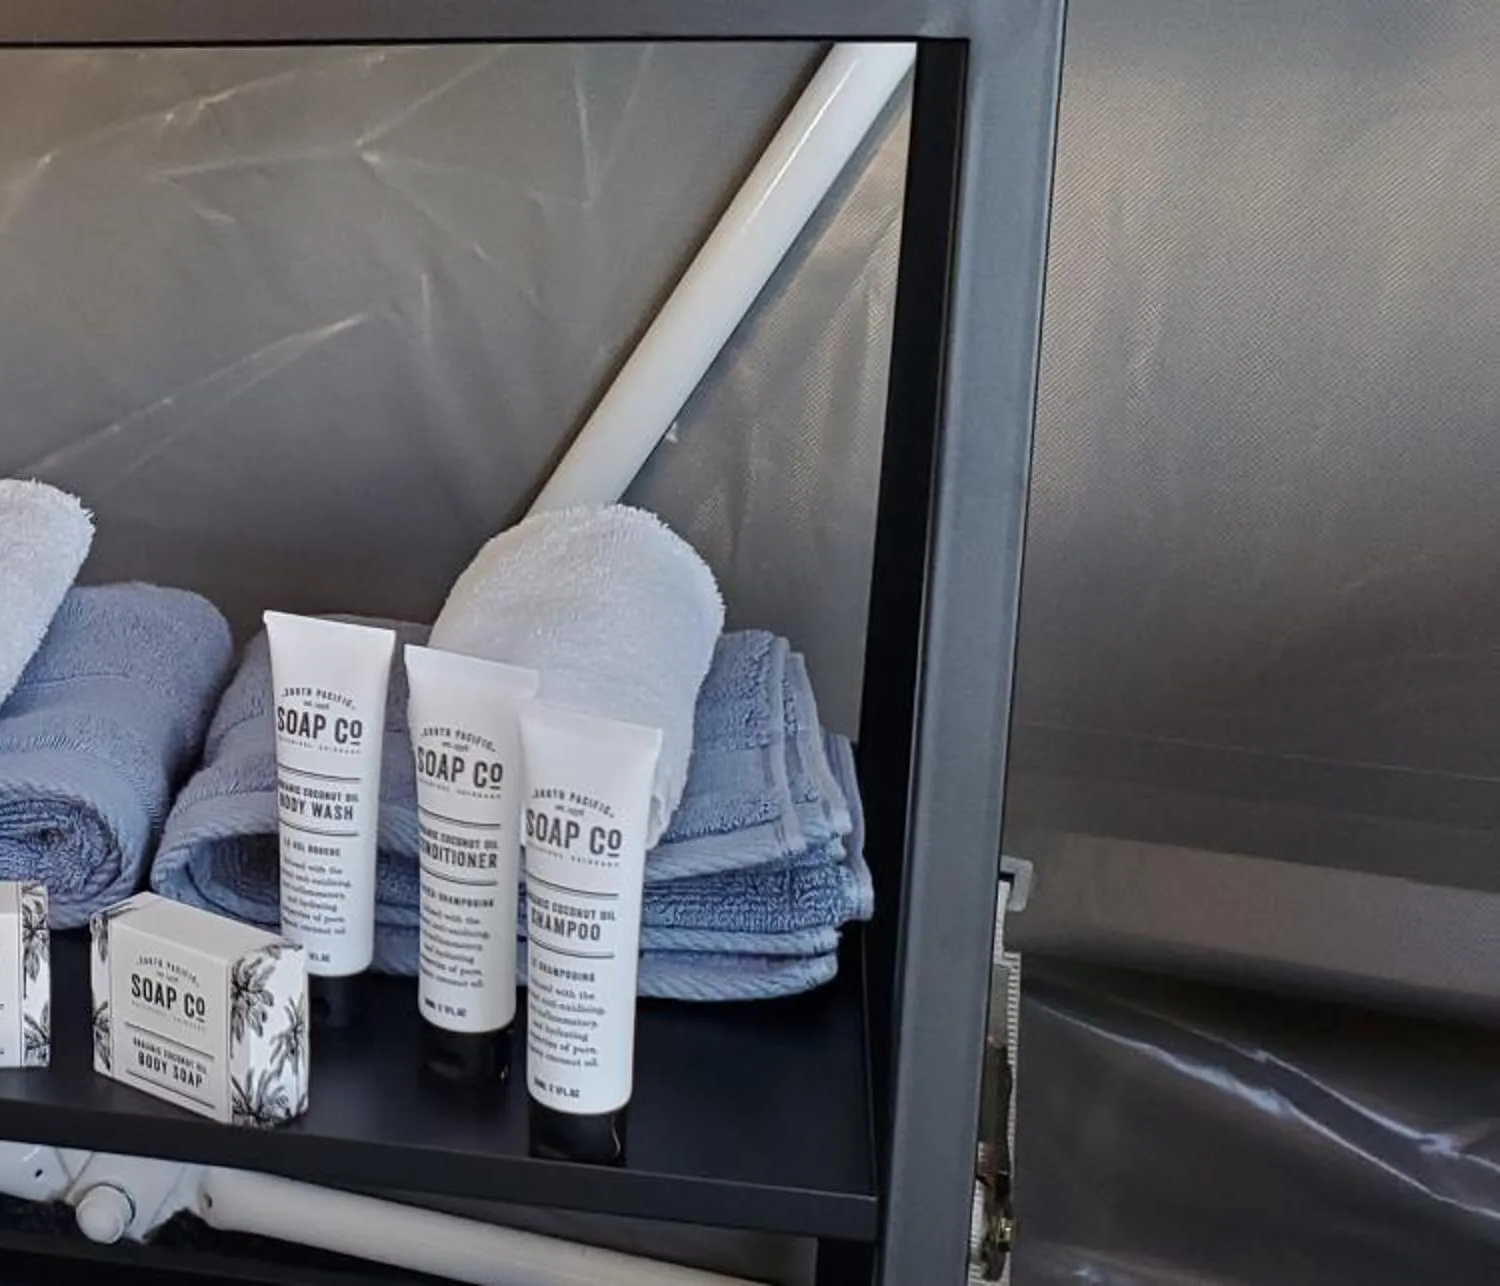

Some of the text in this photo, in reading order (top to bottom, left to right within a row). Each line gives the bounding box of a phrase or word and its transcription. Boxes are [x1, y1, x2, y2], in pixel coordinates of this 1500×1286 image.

[277, 705, 326, 739] SOAP
[418, 745, 465, 782] SOAP
[312, 801, 353, 820] WASH
[526, 808, 580, 848] SOAP
[531, 907, 601, 941] SHAMPOO
[552, 902, 596, 920] COCONUT
[131, 973, 177, 1010] SOAP
[138, 1050, 203, 1088] BODY SOAP
